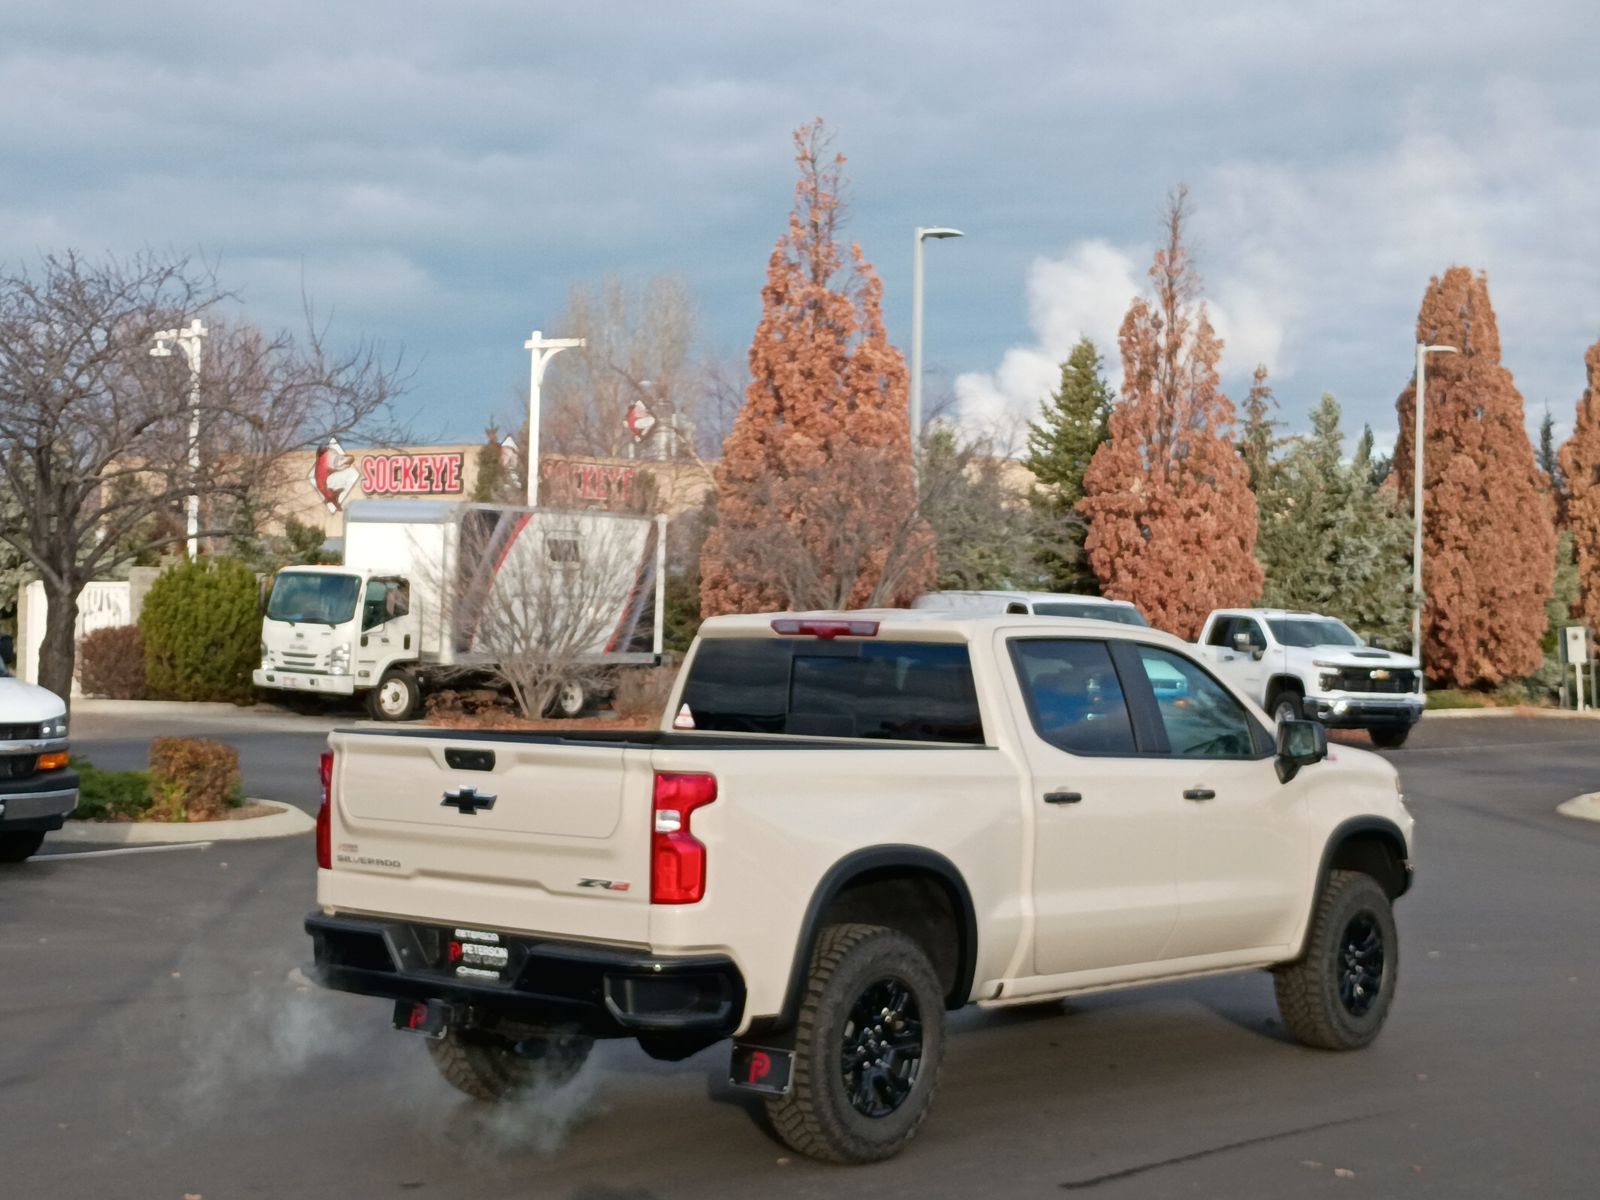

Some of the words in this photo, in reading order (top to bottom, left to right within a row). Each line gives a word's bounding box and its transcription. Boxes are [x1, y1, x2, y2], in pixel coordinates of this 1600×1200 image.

[362, 454, 461, 493] SOCKEYE
[337, 854, 401, 868] SILVERADO
[576, 878, 631, 891] ZR2
